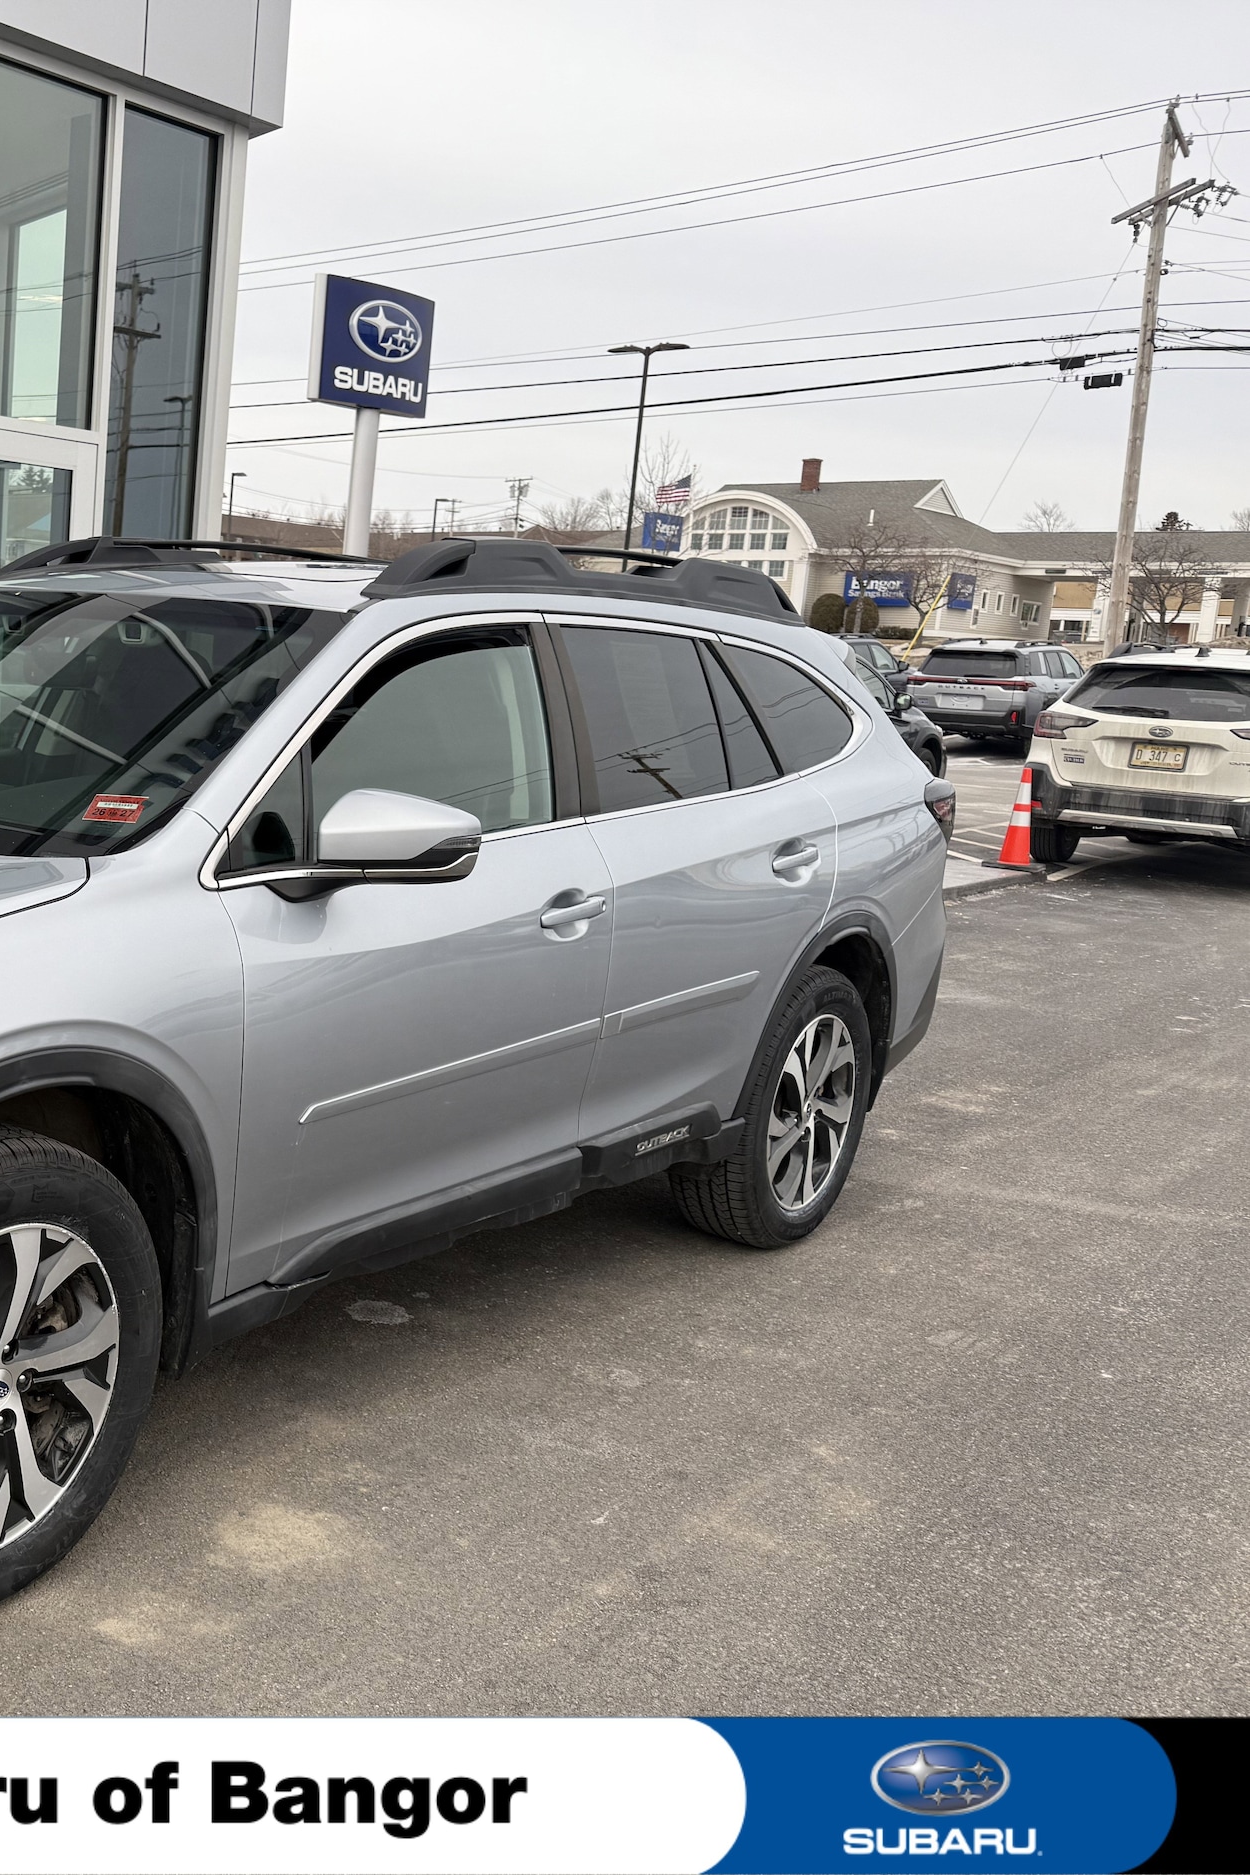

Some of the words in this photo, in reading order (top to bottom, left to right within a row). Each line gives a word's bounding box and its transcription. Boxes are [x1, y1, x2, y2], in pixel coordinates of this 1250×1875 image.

[333, 365, 423, 403] SUBARU
[847, 589, 881, 599] Sangs
[1136, 749, 1143, 760] D
[1149, 750, 1168, 762] 347
[1174, 753, 1181, 762] C
[92, 808, 107, 816] 26
[636, 1125, 690, 1152] OUTBACK
